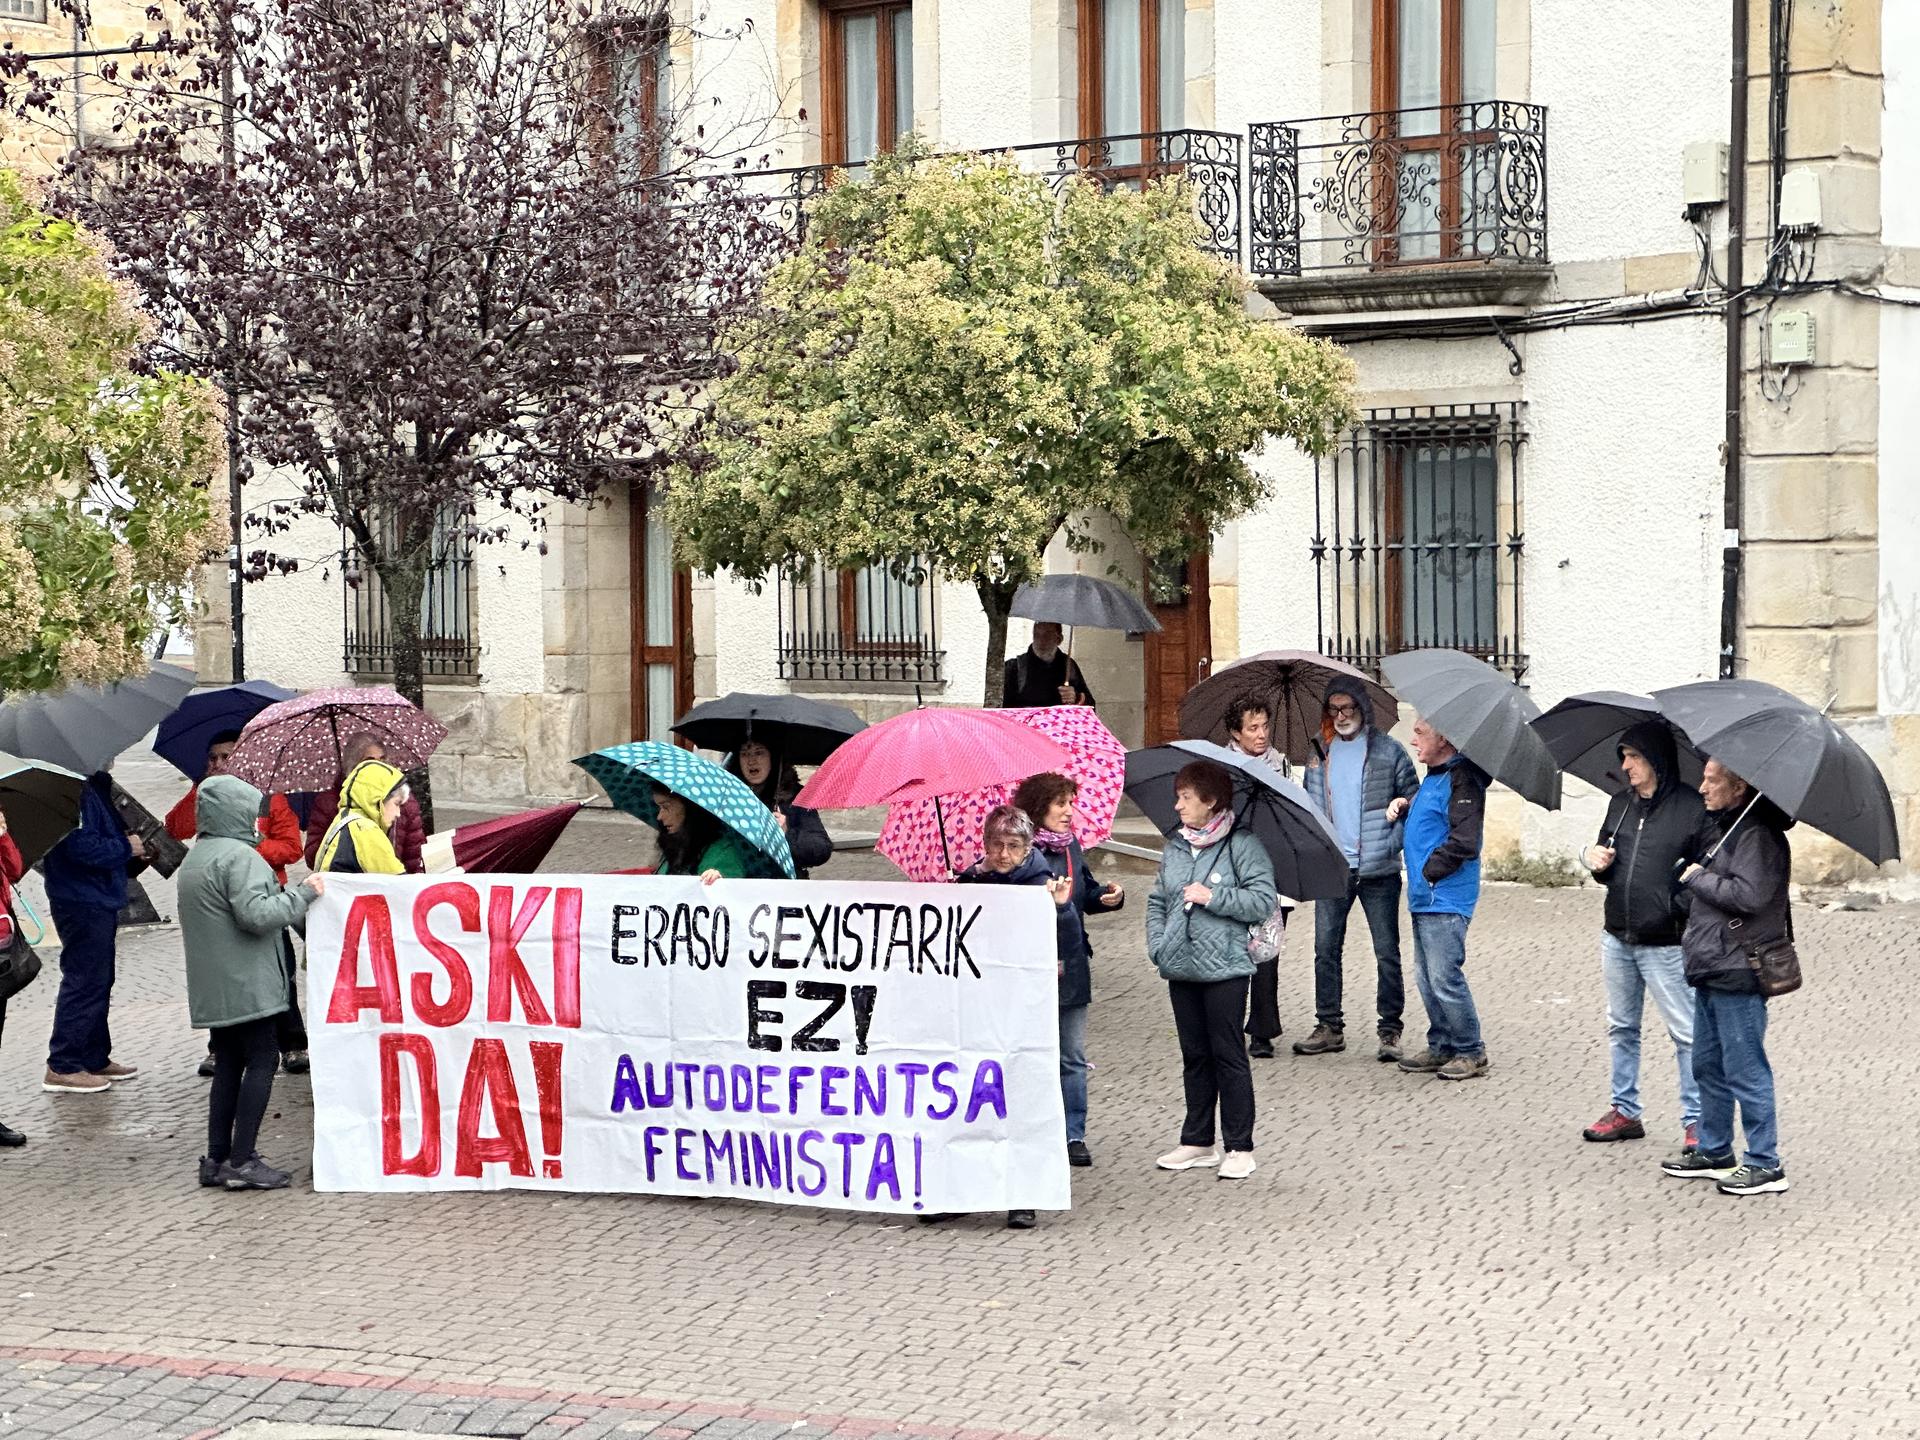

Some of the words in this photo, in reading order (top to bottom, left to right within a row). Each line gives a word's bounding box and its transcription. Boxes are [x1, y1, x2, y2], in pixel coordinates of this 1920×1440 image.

[326, 882, 582, 1029] ASKI
[610, 904, 730, 970] ERASO
[749, 903, 982, 978] SEXISTARIK
[747, 979, 878, 1055] EZ!
[380, 1033, 563, 1179] DA!
[610, 1053, 1008, 1122] AUTODEFENTSA
[644, 1126, 925, 1210] FEMINISTA!
